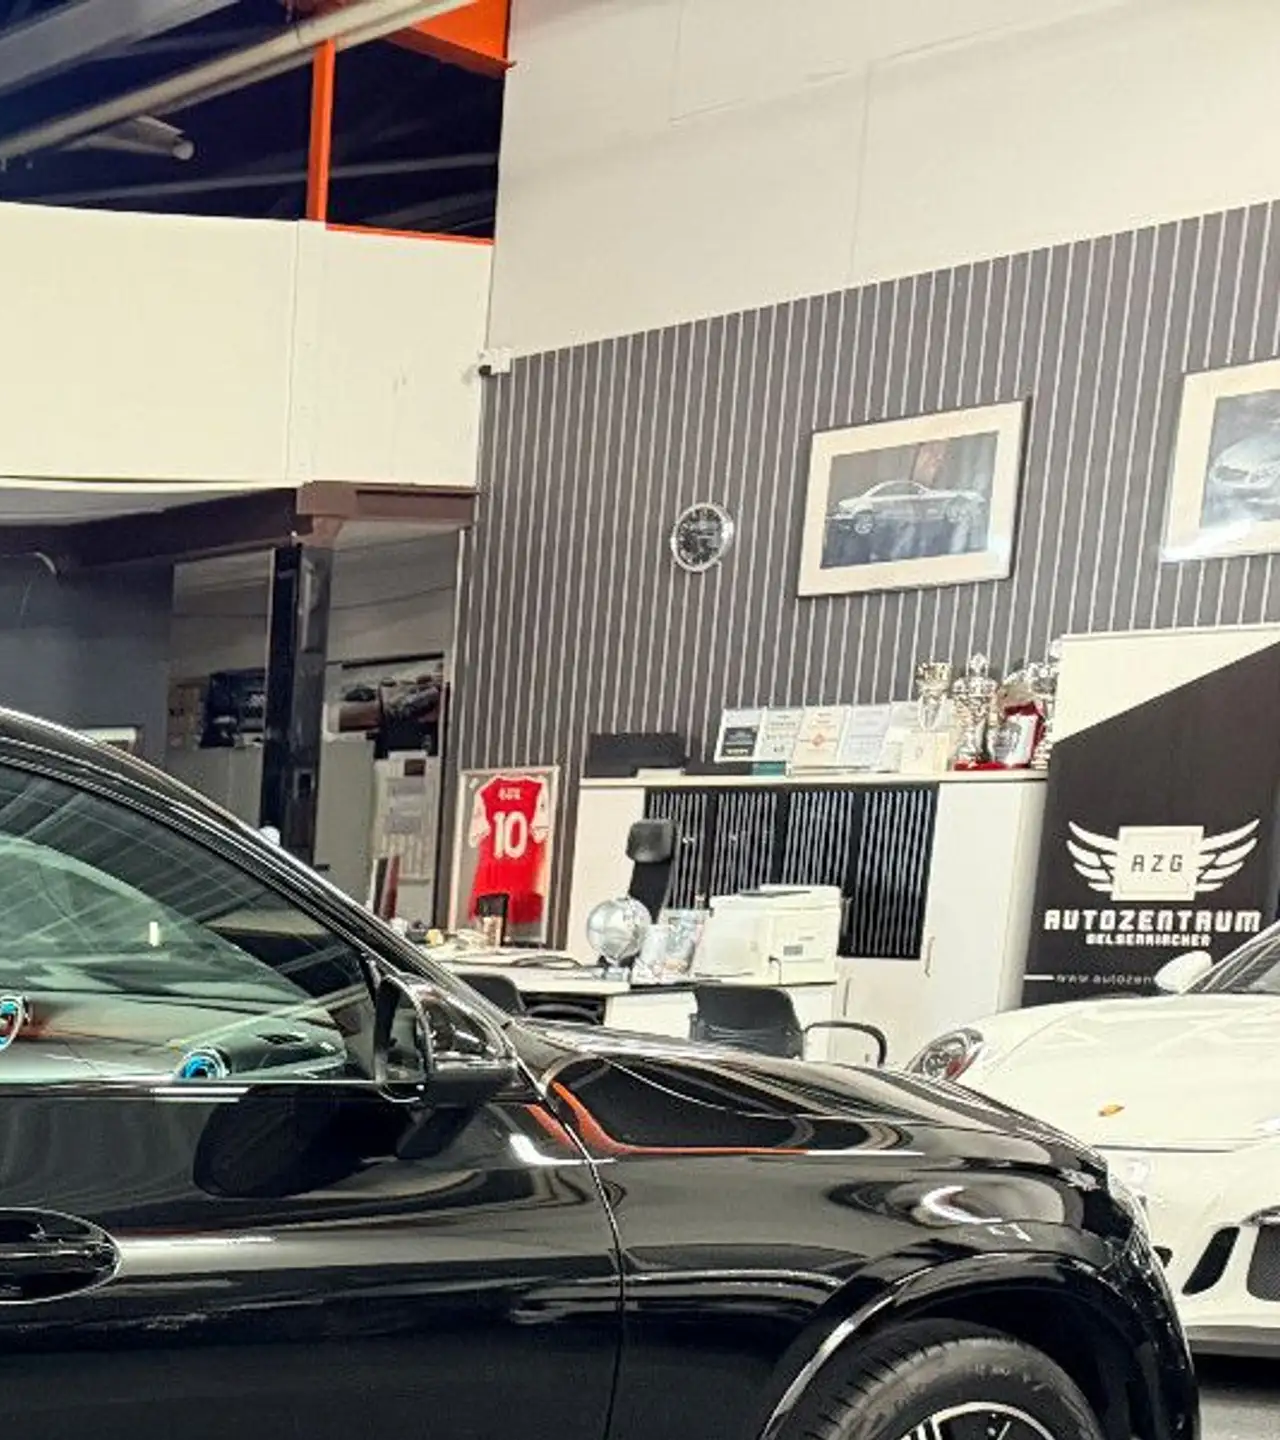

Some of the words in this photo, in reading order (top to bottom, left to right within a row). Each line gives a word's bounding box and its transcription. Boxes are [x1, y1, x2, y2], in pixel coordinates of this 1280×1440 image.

[493, 811, 528, 859] 10
[1131, 854, 1183, 873] AZG
[1044, 910, 1261, 932] AUTOZENTRUM
